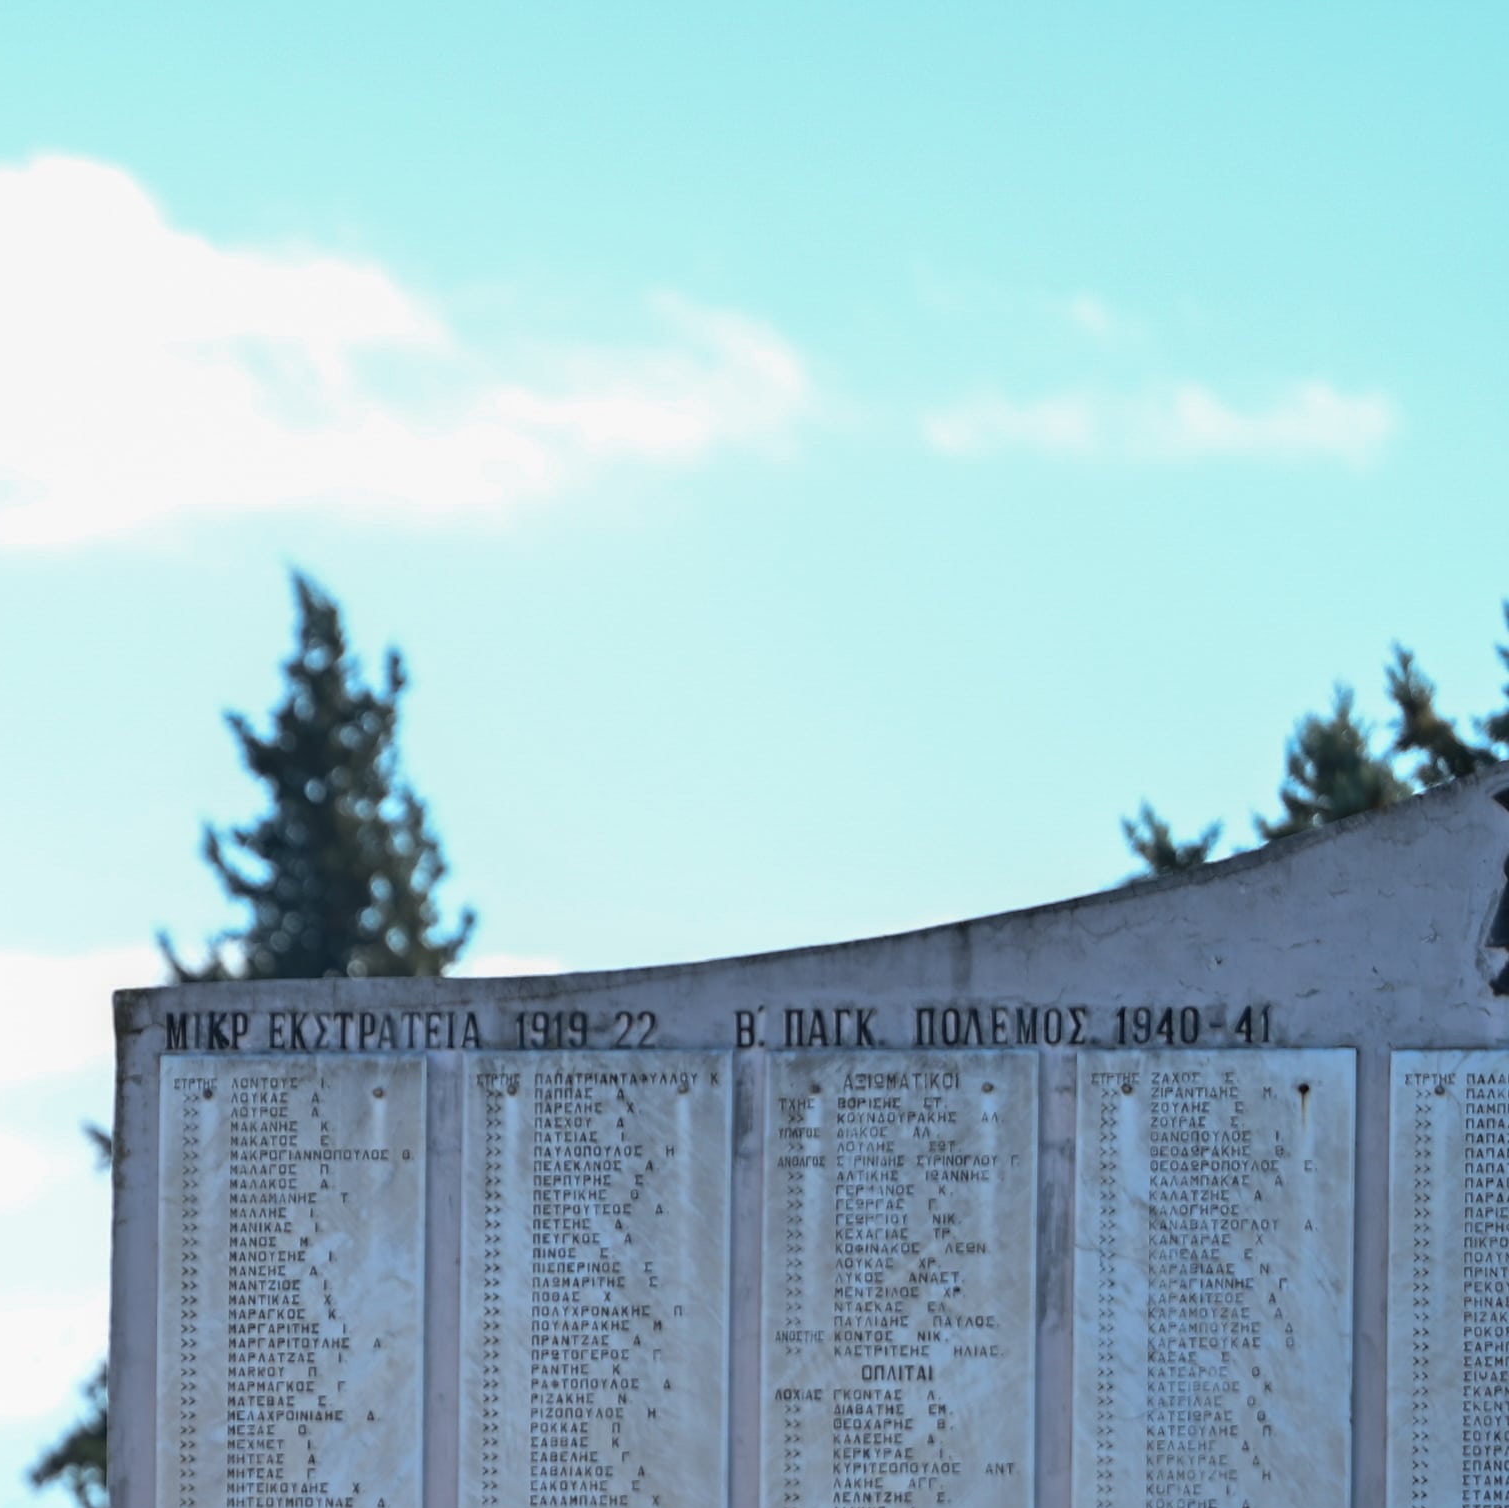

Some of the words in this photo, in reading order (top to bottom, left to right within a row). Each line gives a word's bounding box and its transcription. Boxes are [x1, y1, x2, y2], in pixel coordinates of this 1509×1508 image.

[269, 1010, 482, 1050] ΕΚΣΤΡΑΤΕΙΑ
[843, 1072, 960, 1091] ΑΞΙΩΜΑΤΙΚΟΙ
[861, 1364, 934, 1383] ΟΠΛΙΤΑΙ
